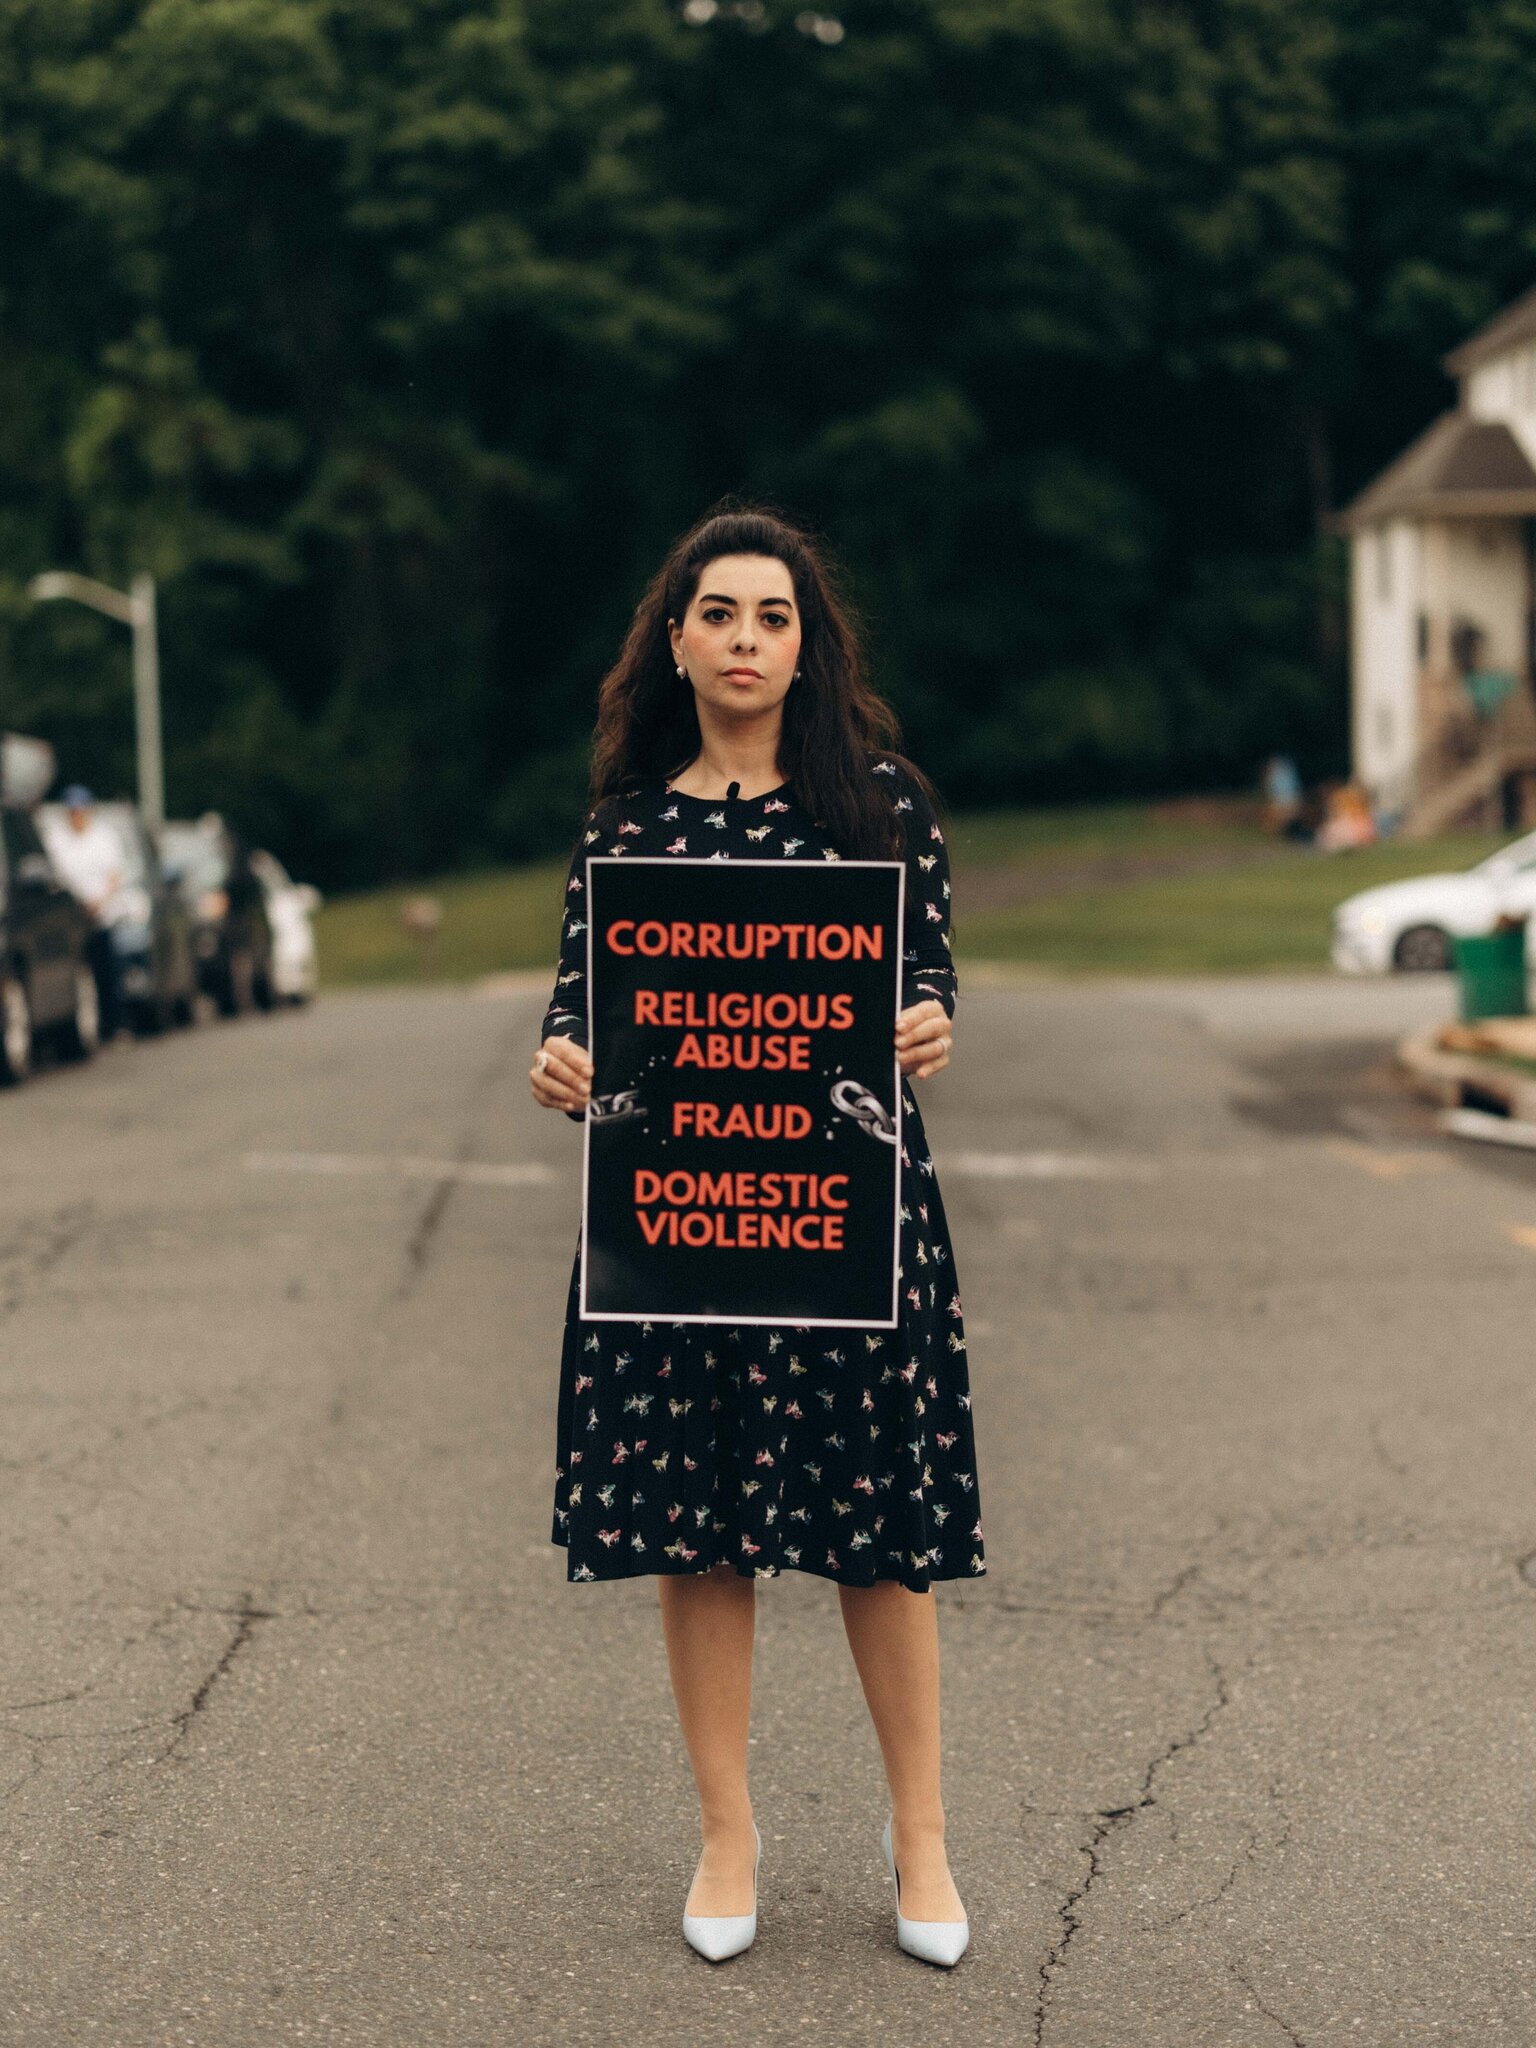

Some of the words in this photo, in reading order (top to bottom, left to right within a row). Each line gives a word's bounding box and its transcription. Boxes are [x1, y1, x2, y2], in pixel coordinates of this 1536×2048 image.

[606, 920, 883, 960] CORRUPTION
[634, 990, 855, 1030] RELIGIOUS
[673, 1033, 811, 1071] ABUSE
[673, 1102, 812, 1140] FRAUD
[634, 1169, 849, 1210] DOMESTIC
[636, 1210, 844, 1250] VIOLENCE
